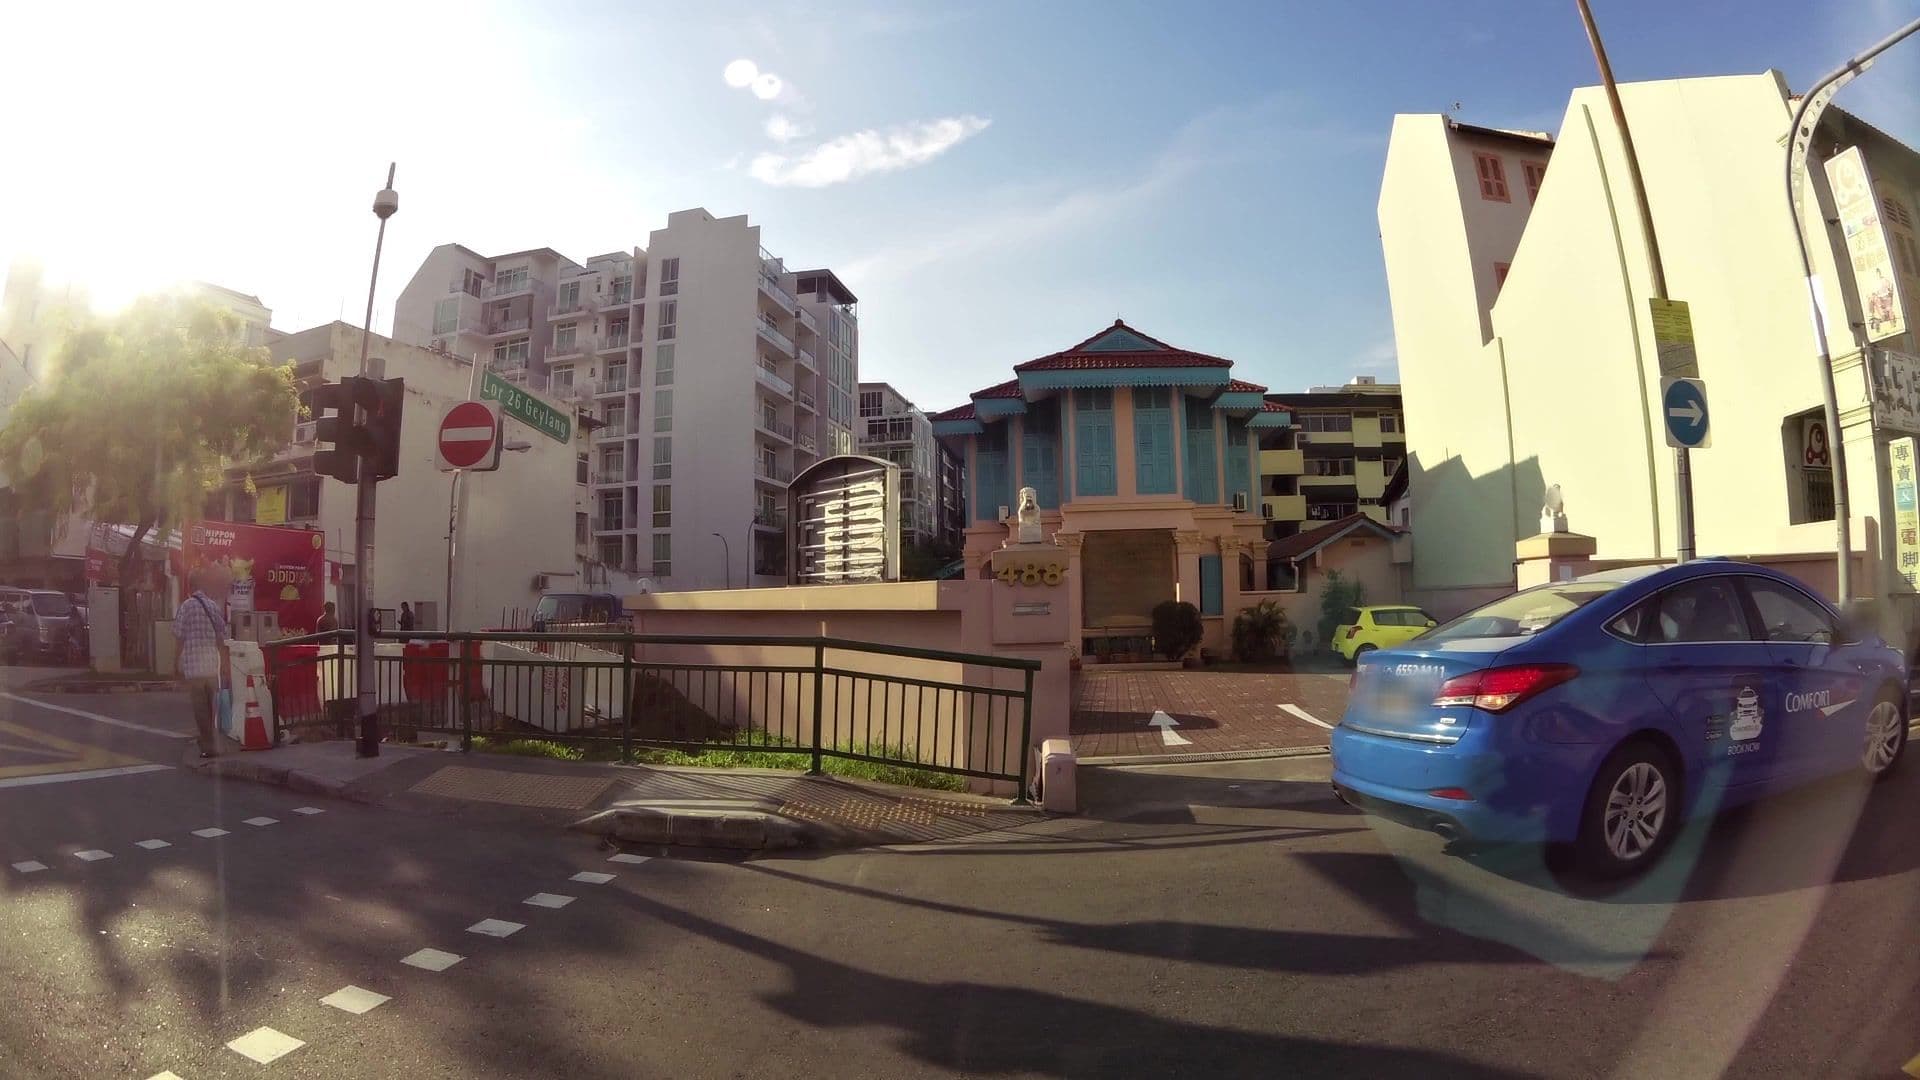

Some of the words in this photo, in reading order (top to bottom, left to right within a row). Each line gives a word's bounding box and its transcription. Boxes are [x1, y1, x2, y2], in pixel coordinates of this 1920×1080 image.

[483, 375, 504, 399] Lor
[507, 390, 521, 409] 26
[525, 398, 566, 438] Geylang
[205, 529, 235, 540] NIPPON
[209, 537, 233, 547] PAINT
[997, 561, 1064, 587] 488
[1785, 689, 1831, 713] COMFORT
